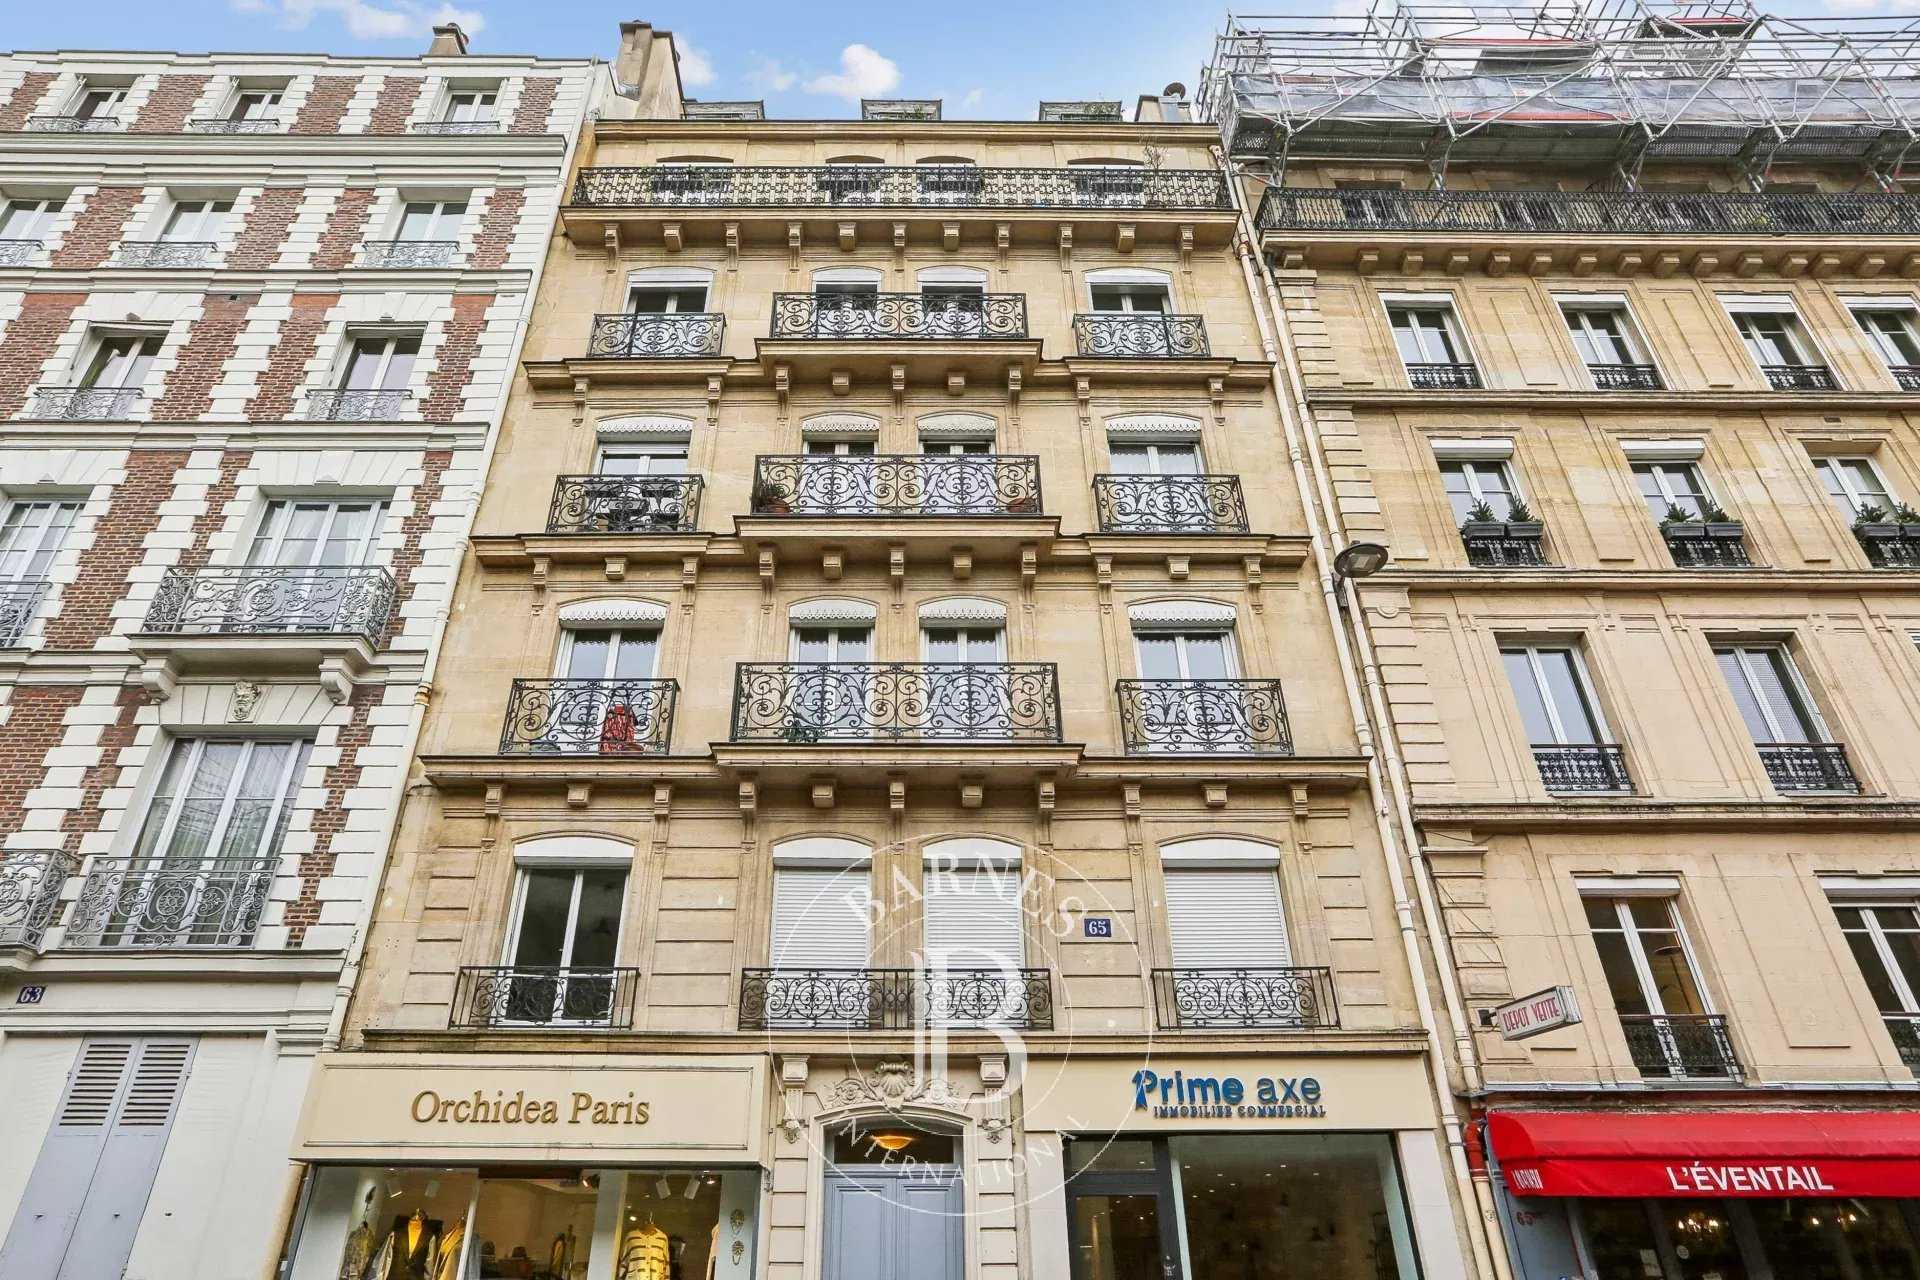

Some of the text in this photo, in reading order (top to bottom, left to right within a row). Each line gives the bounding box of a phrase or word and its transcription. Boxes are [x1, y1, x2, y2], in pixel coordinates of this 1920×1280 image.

[1089, 920, 1107, 935] 65
[21, 987, 42, 1003] 63
[1502, 1007, 1530, 1032] DEPOT
[1132, 1069, 1321, 1111] Prime axe
[411, 1090, 650, 1125] Orchidea Paris
[1153, 1104, 1327, 1118] IMMOBILIER COMMERCIAL
[1665, 1161, 1834, 1191] L'ÉVENTAIL
